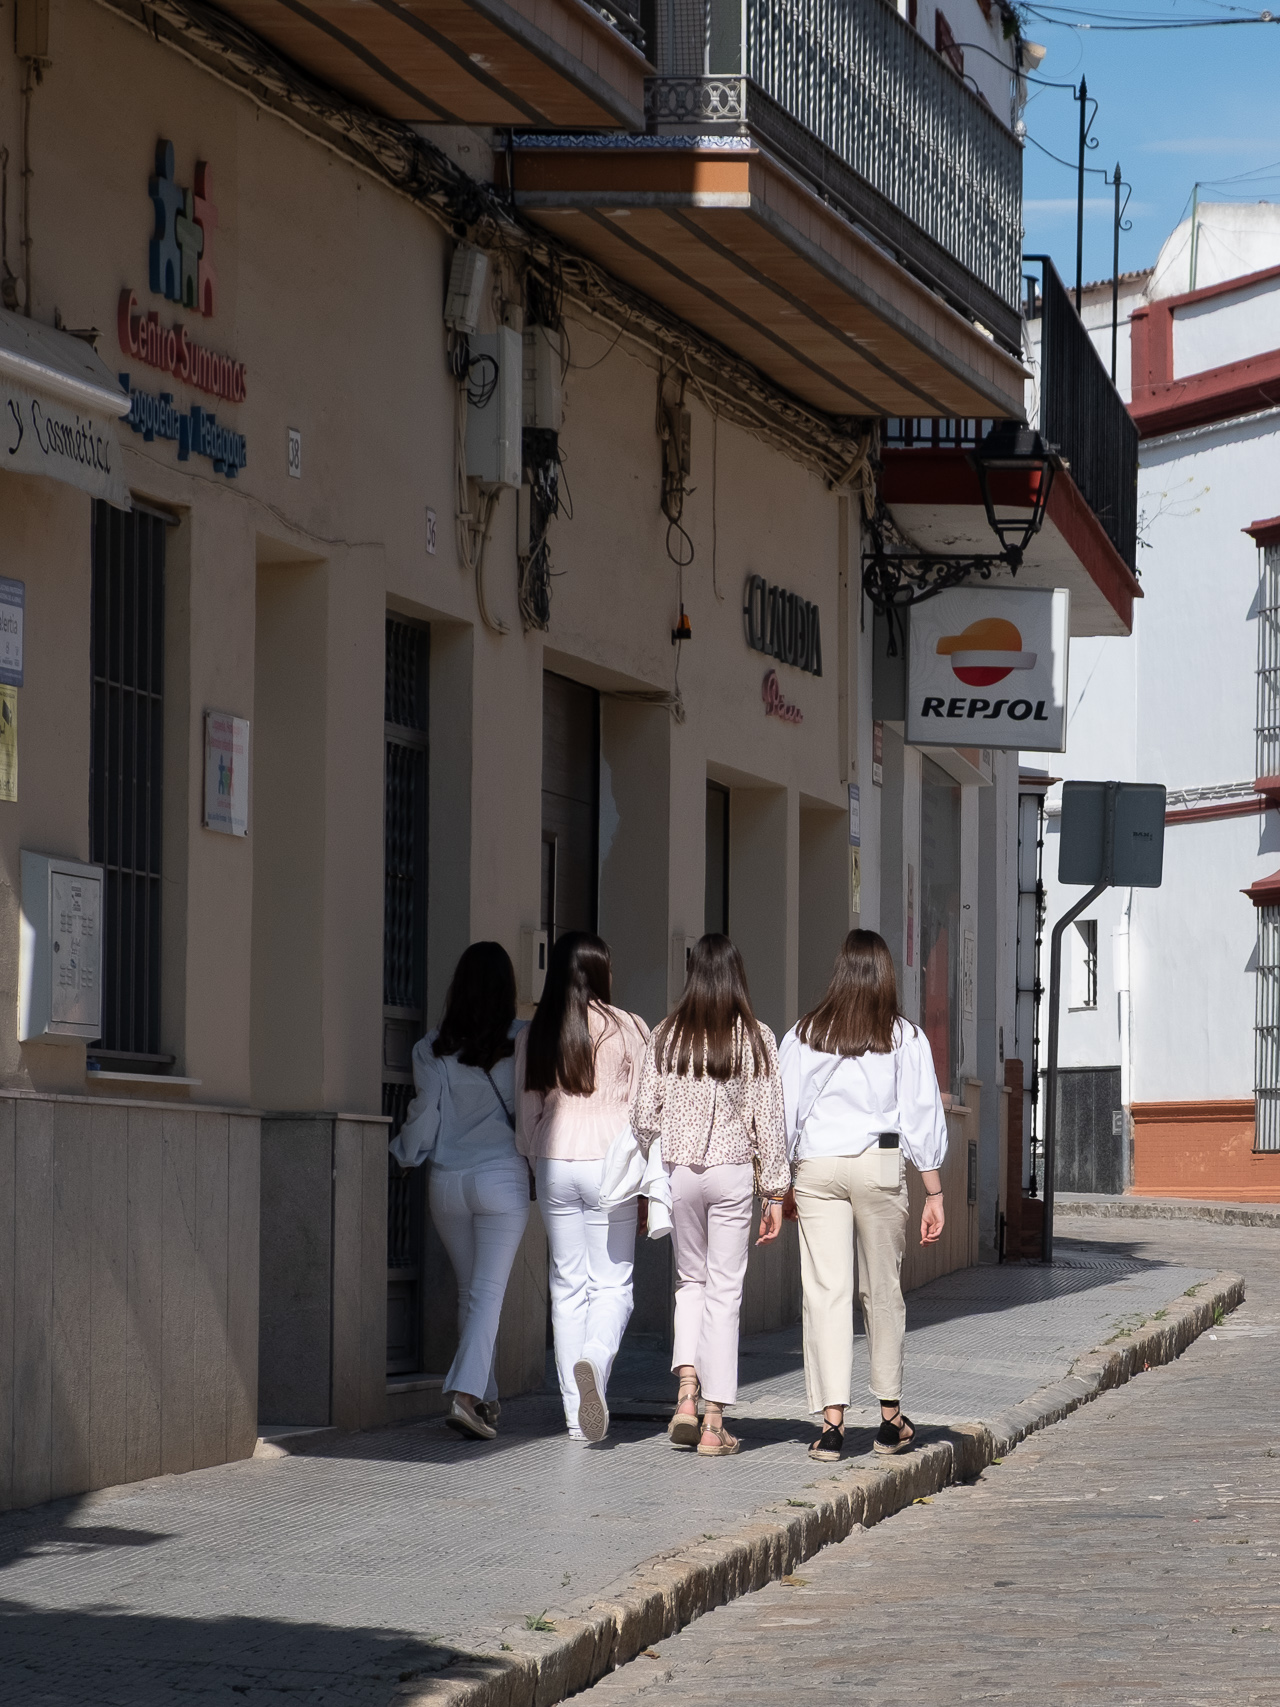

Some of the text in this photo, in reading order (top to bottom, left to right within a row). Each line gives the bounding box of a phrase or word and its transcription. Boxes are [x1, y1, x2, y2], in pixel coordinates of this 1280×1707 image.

[119, 289, 247, 402] Centro Sumamos
[8, 399, 23, 455] y
[289, 437, 299, 470] 38
[427, 517, 436, 548] 36
[745, 574, 822, 677] CLAUDIA
[921, 697, 1048, 721] REPSOL
